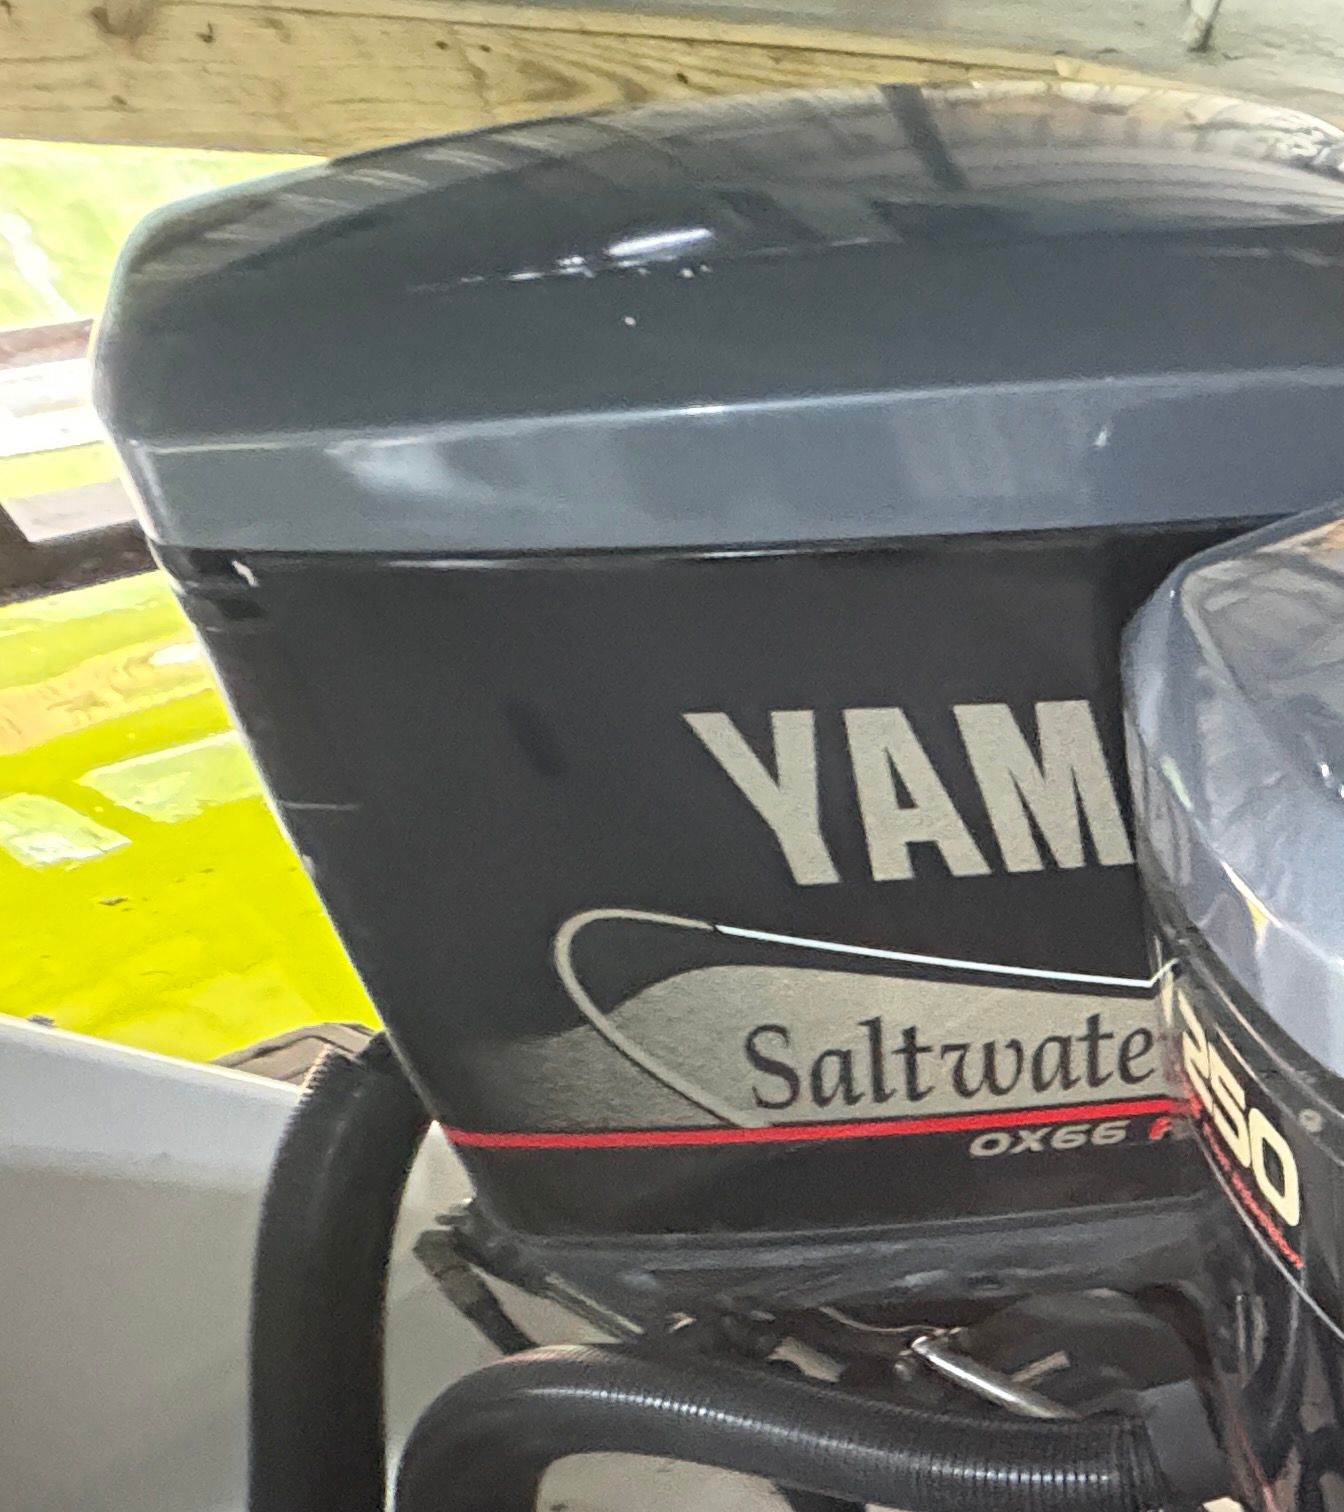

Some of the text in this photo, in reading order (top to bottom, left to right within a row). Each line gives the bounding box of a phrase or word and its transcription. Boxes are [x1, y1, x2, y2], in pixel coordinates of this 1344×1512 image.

[683, 700, 1135, 885] YAM
[744, 1014, 1158, 1110] Saltwate
[1177, 985, 1299, 1227] 250
